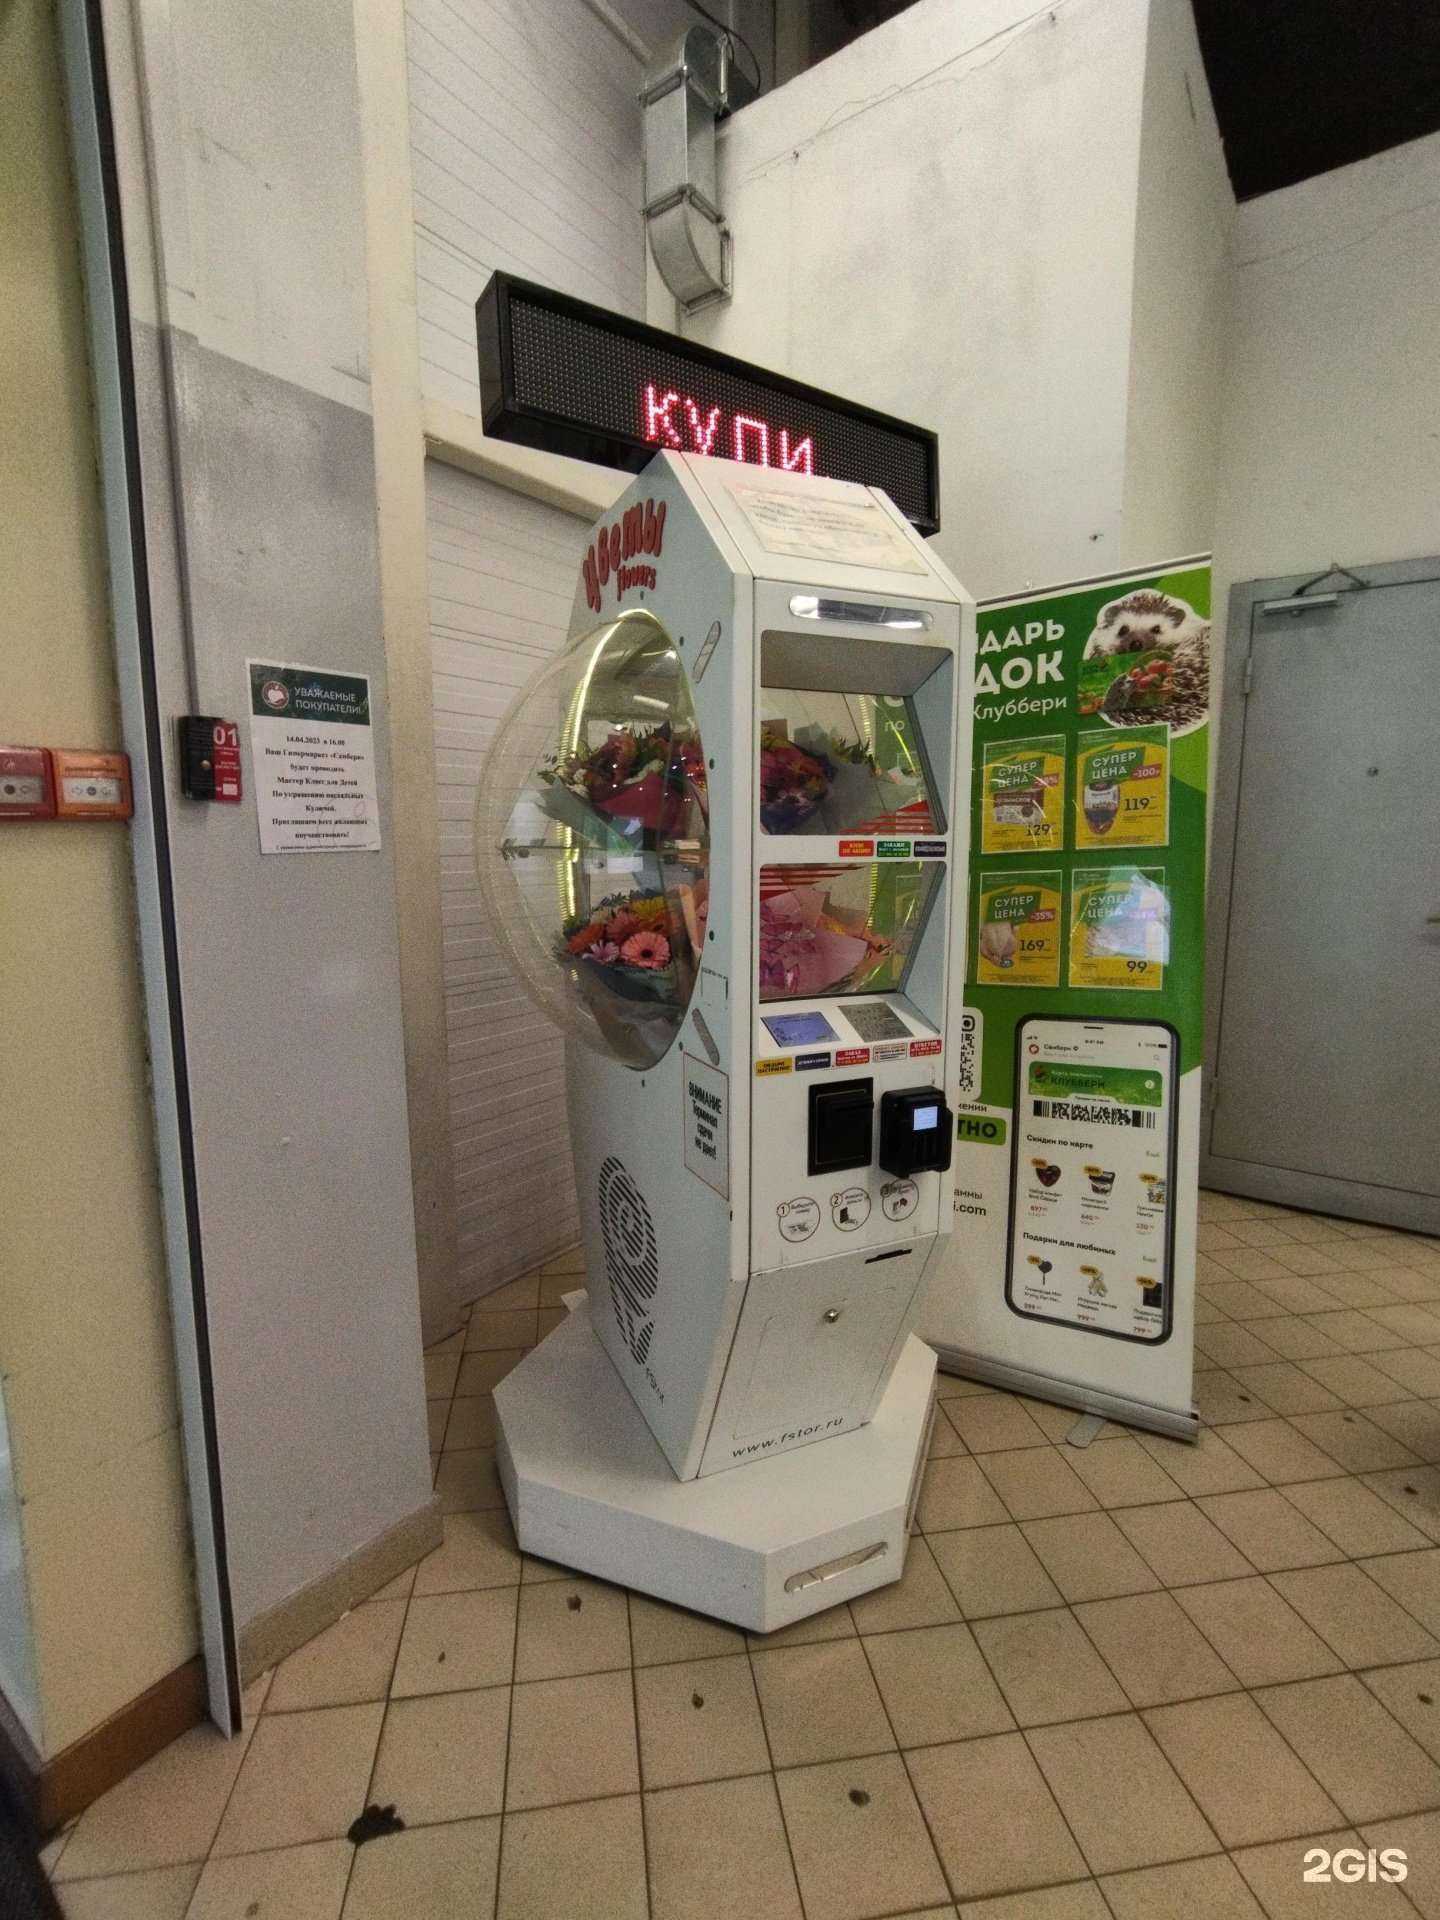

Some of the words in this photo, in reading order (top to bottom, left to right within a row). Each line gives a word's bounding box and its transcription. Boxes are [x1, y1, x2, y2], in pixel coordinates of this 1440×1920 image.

[646, 385, 813, 478] КУПИ
[294, 687, 356, 703] УВАЖАЕМЫЕ
[213, 726, 237, 746] 01
[1092, 752, 1136, 767] СУПЕР
[999, 761, 1037, 777] СУПЕР
[1092, 766, 1127, 779] ЦЕНА
[1124, 797, 1150, 810] 119
[994, 895, 1034, 907] СУПЕР
[994, 907, 1025, 919] ЦЕНА
[1020, 939, 1045, 951] 169
[1126, 960, 1148, 973] 99
[1027, 1134, 1057, 1146] Скидки
[1058, 1139, 1068, 1147] по
[1069, 1140, 1094, 1150] карте
[1023, 1231, 1058, 1245] Подарки
[1059, 1238, 1075, 1249] для
[1076, 1242, 1116, 1256] любимых
[732, 1417, 843, 1458] www.fstor.ru
